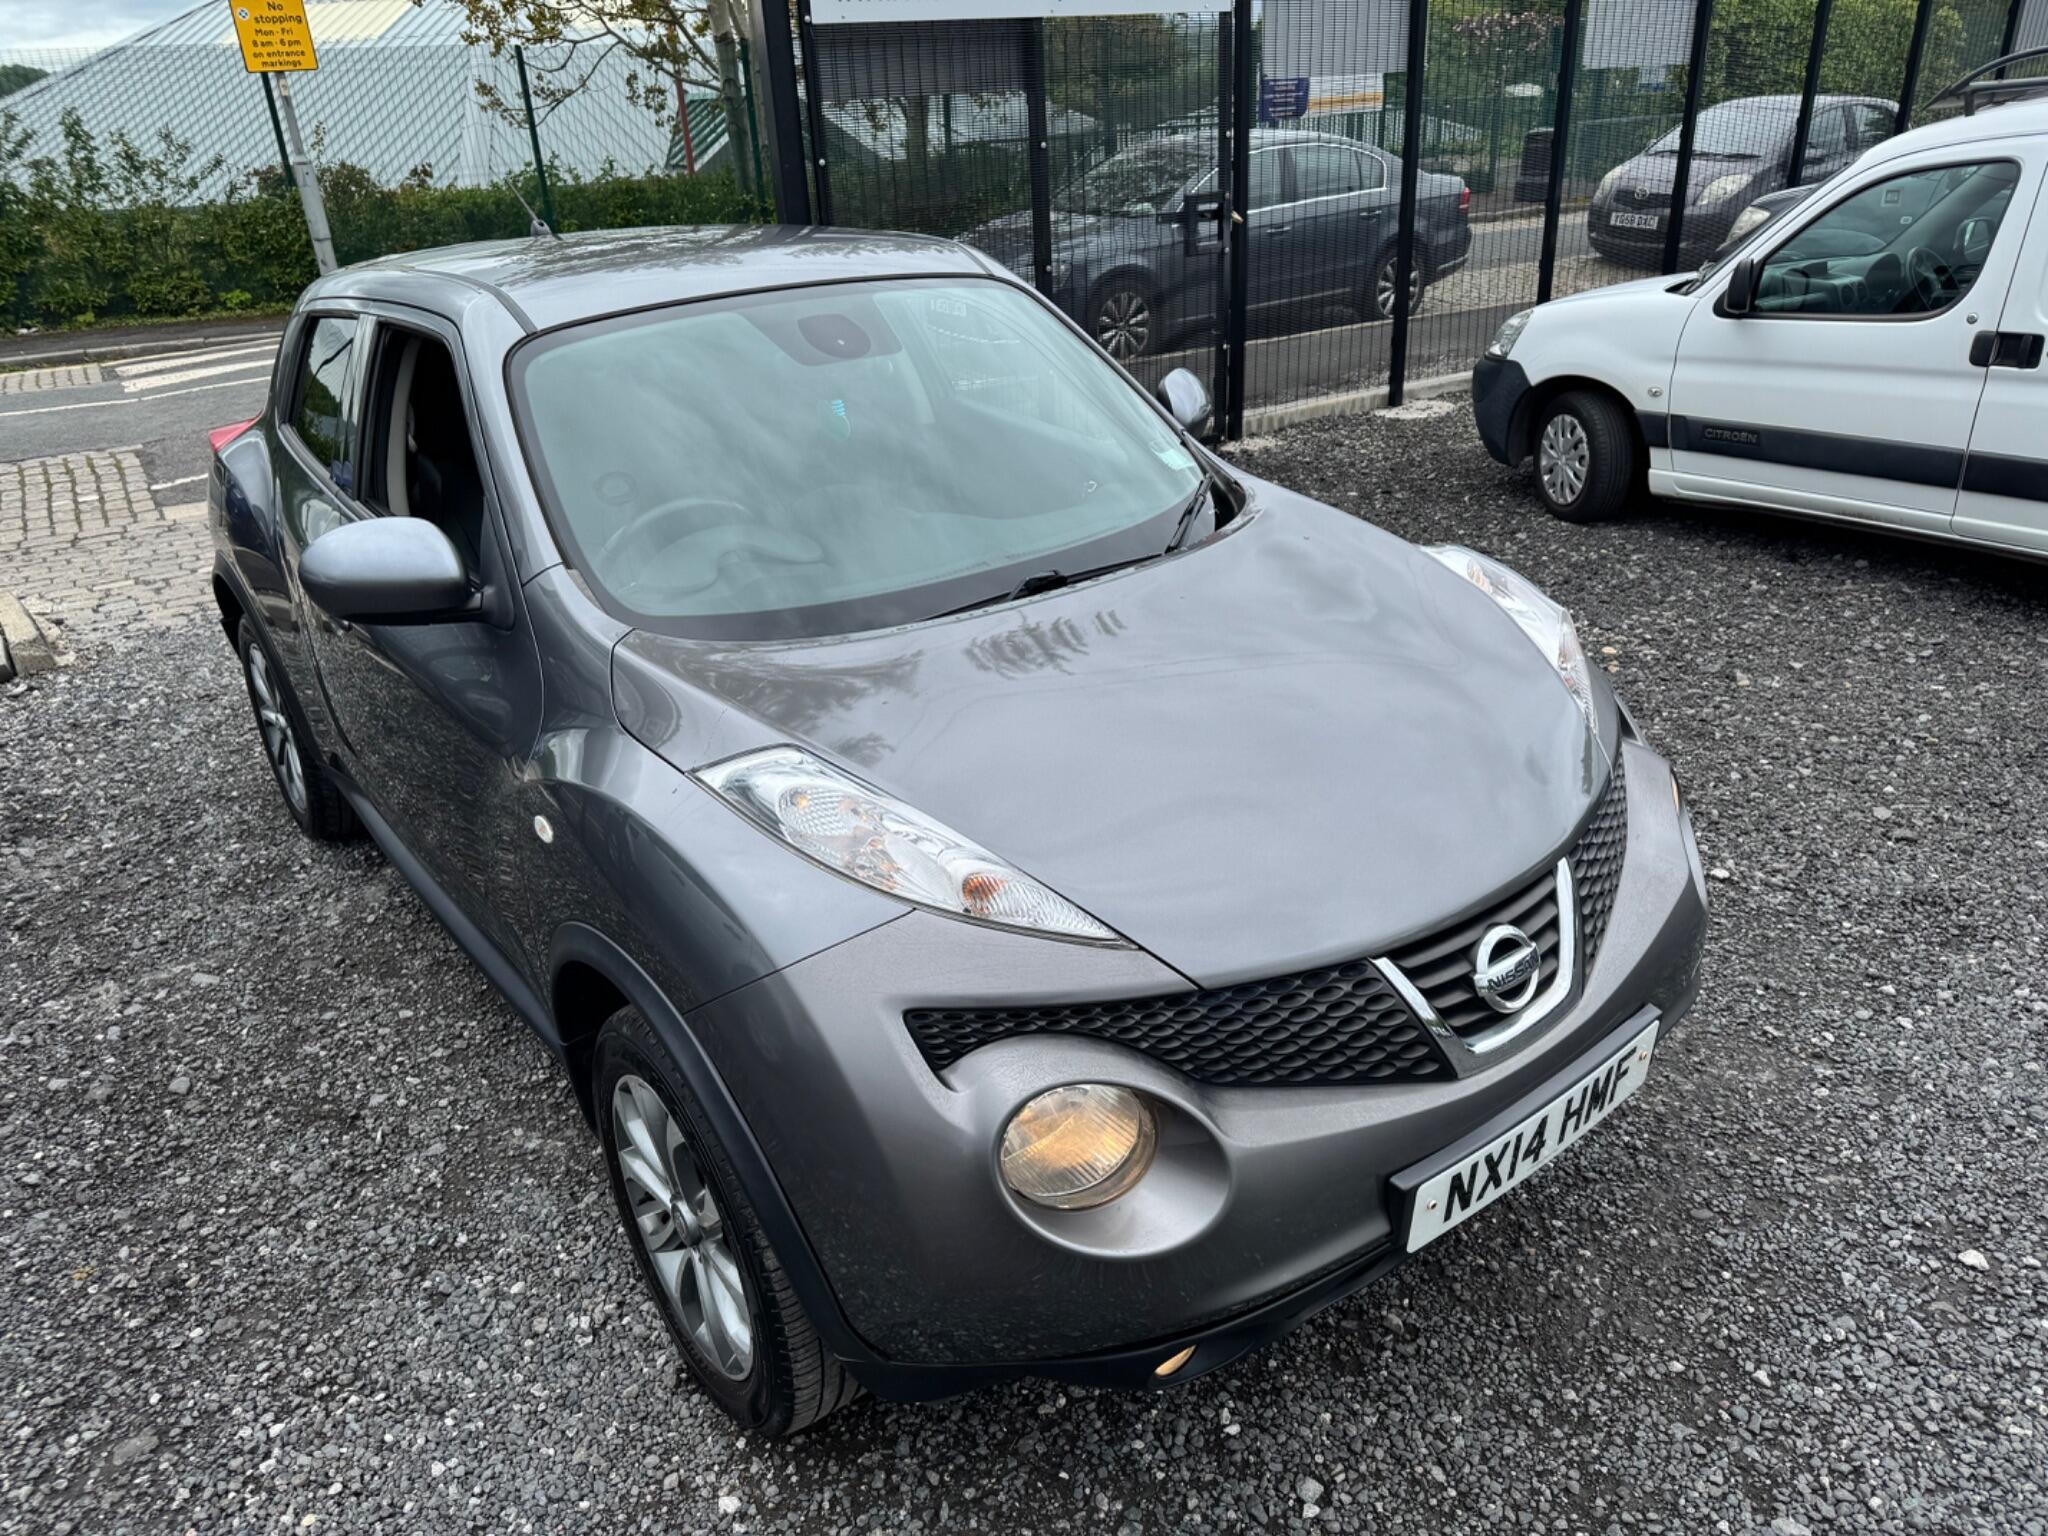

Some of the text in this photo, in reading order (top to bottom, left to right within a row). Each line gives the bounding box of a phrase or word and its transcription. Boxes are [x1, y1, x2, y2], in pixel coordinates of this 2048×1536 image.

[267, 1, 283, 11] No
[254, 14, 302, 24] stopping
[255, 28, 274, 36] Mon
[281, 27, 293, 36] Fri
[262, 59, 301, 67] markings
[1487, 950, 1538, 990] NISSAN
[1443, 1046, 1638, 1223] NX14 HMF
